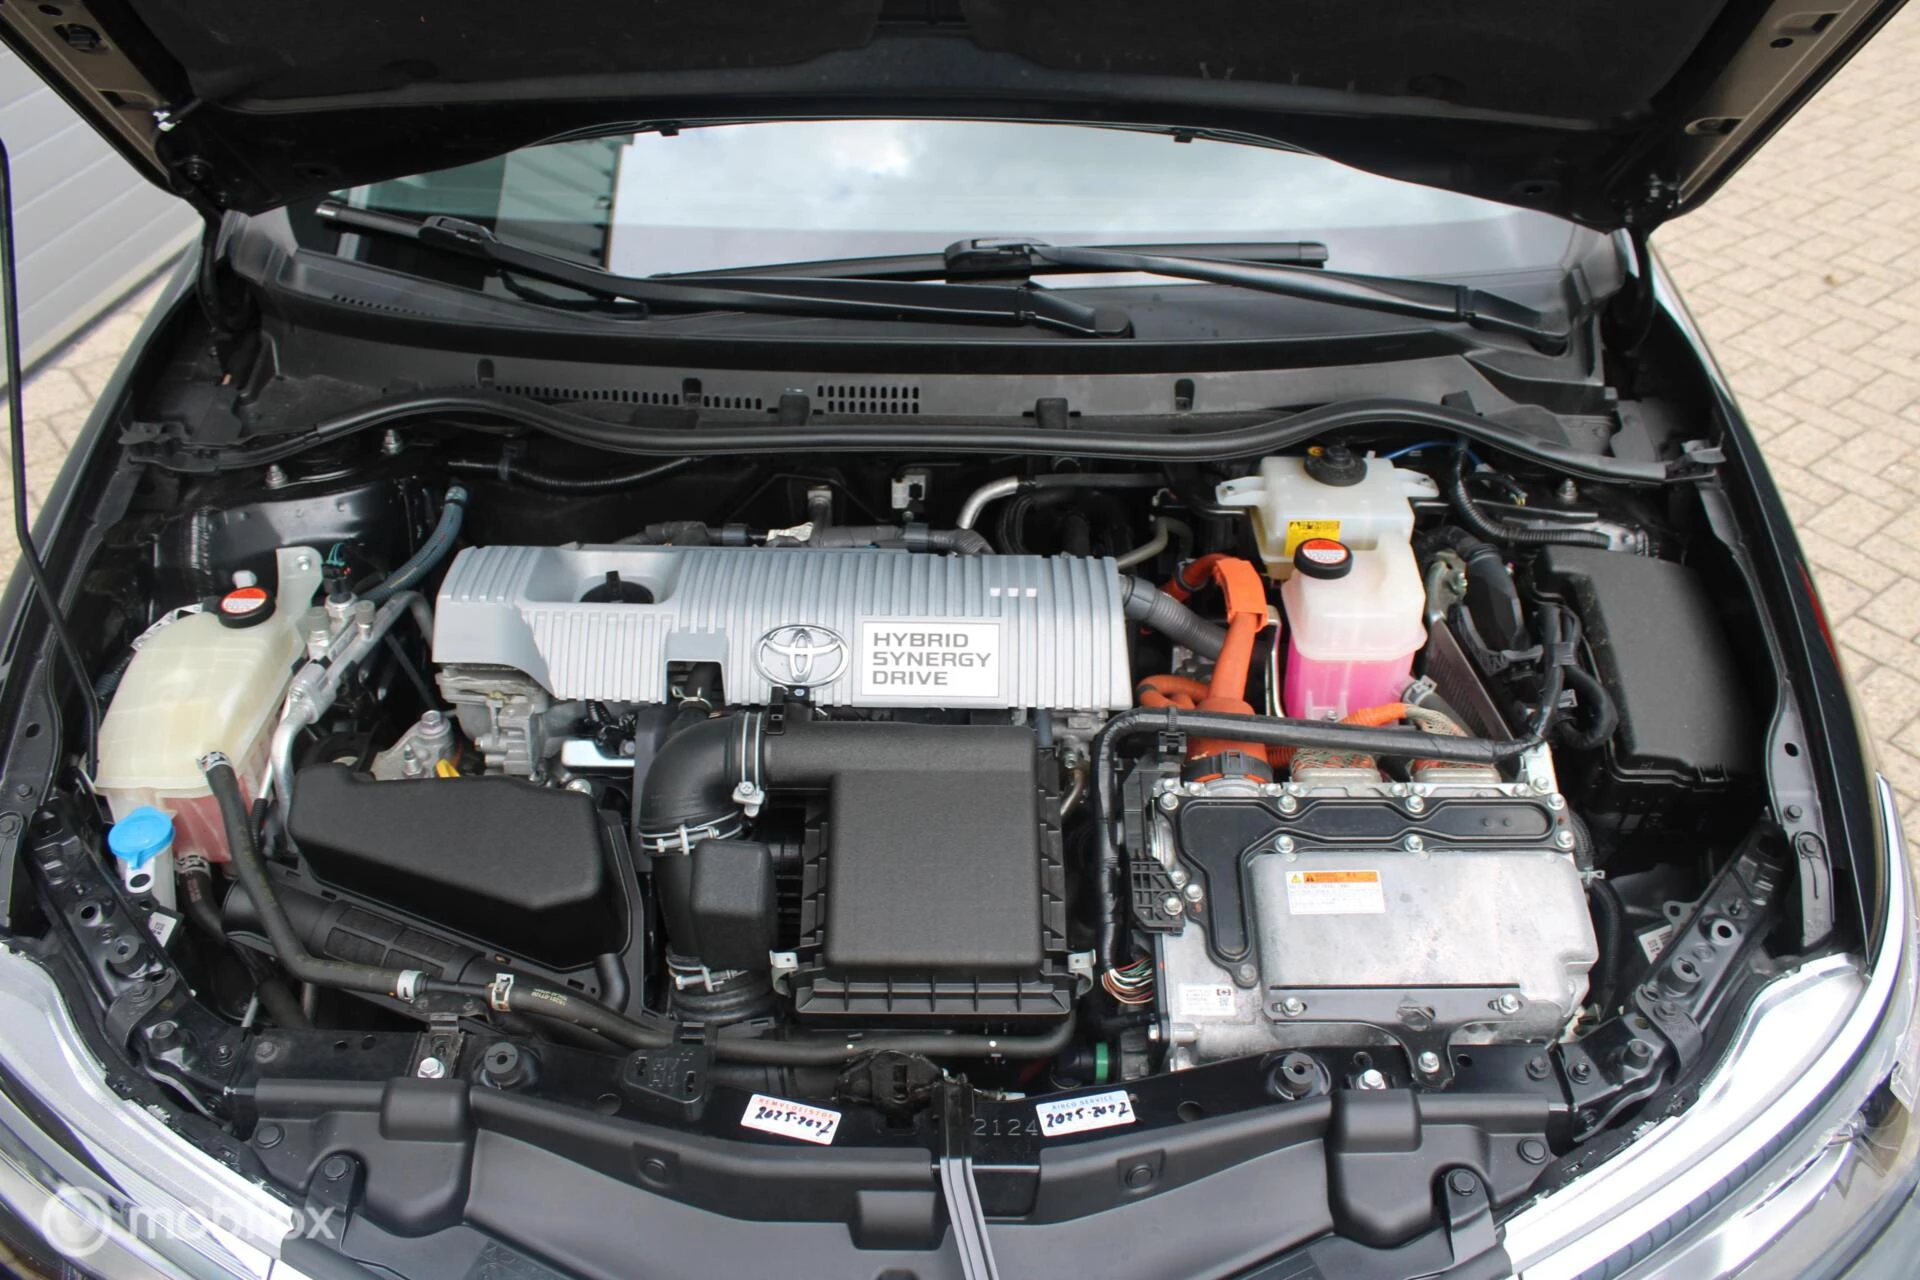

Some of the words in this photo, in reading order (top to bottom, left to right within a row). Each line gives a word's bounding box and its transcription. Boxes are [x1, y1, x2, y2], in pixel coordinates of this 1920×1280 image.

[873, 632, 969, 648] HYBRID
[872, 652, 991, 668] SYNERGY
[872, 671, 948, 686] DRIVE
[973, 1118, 1039, 1137] 2124
